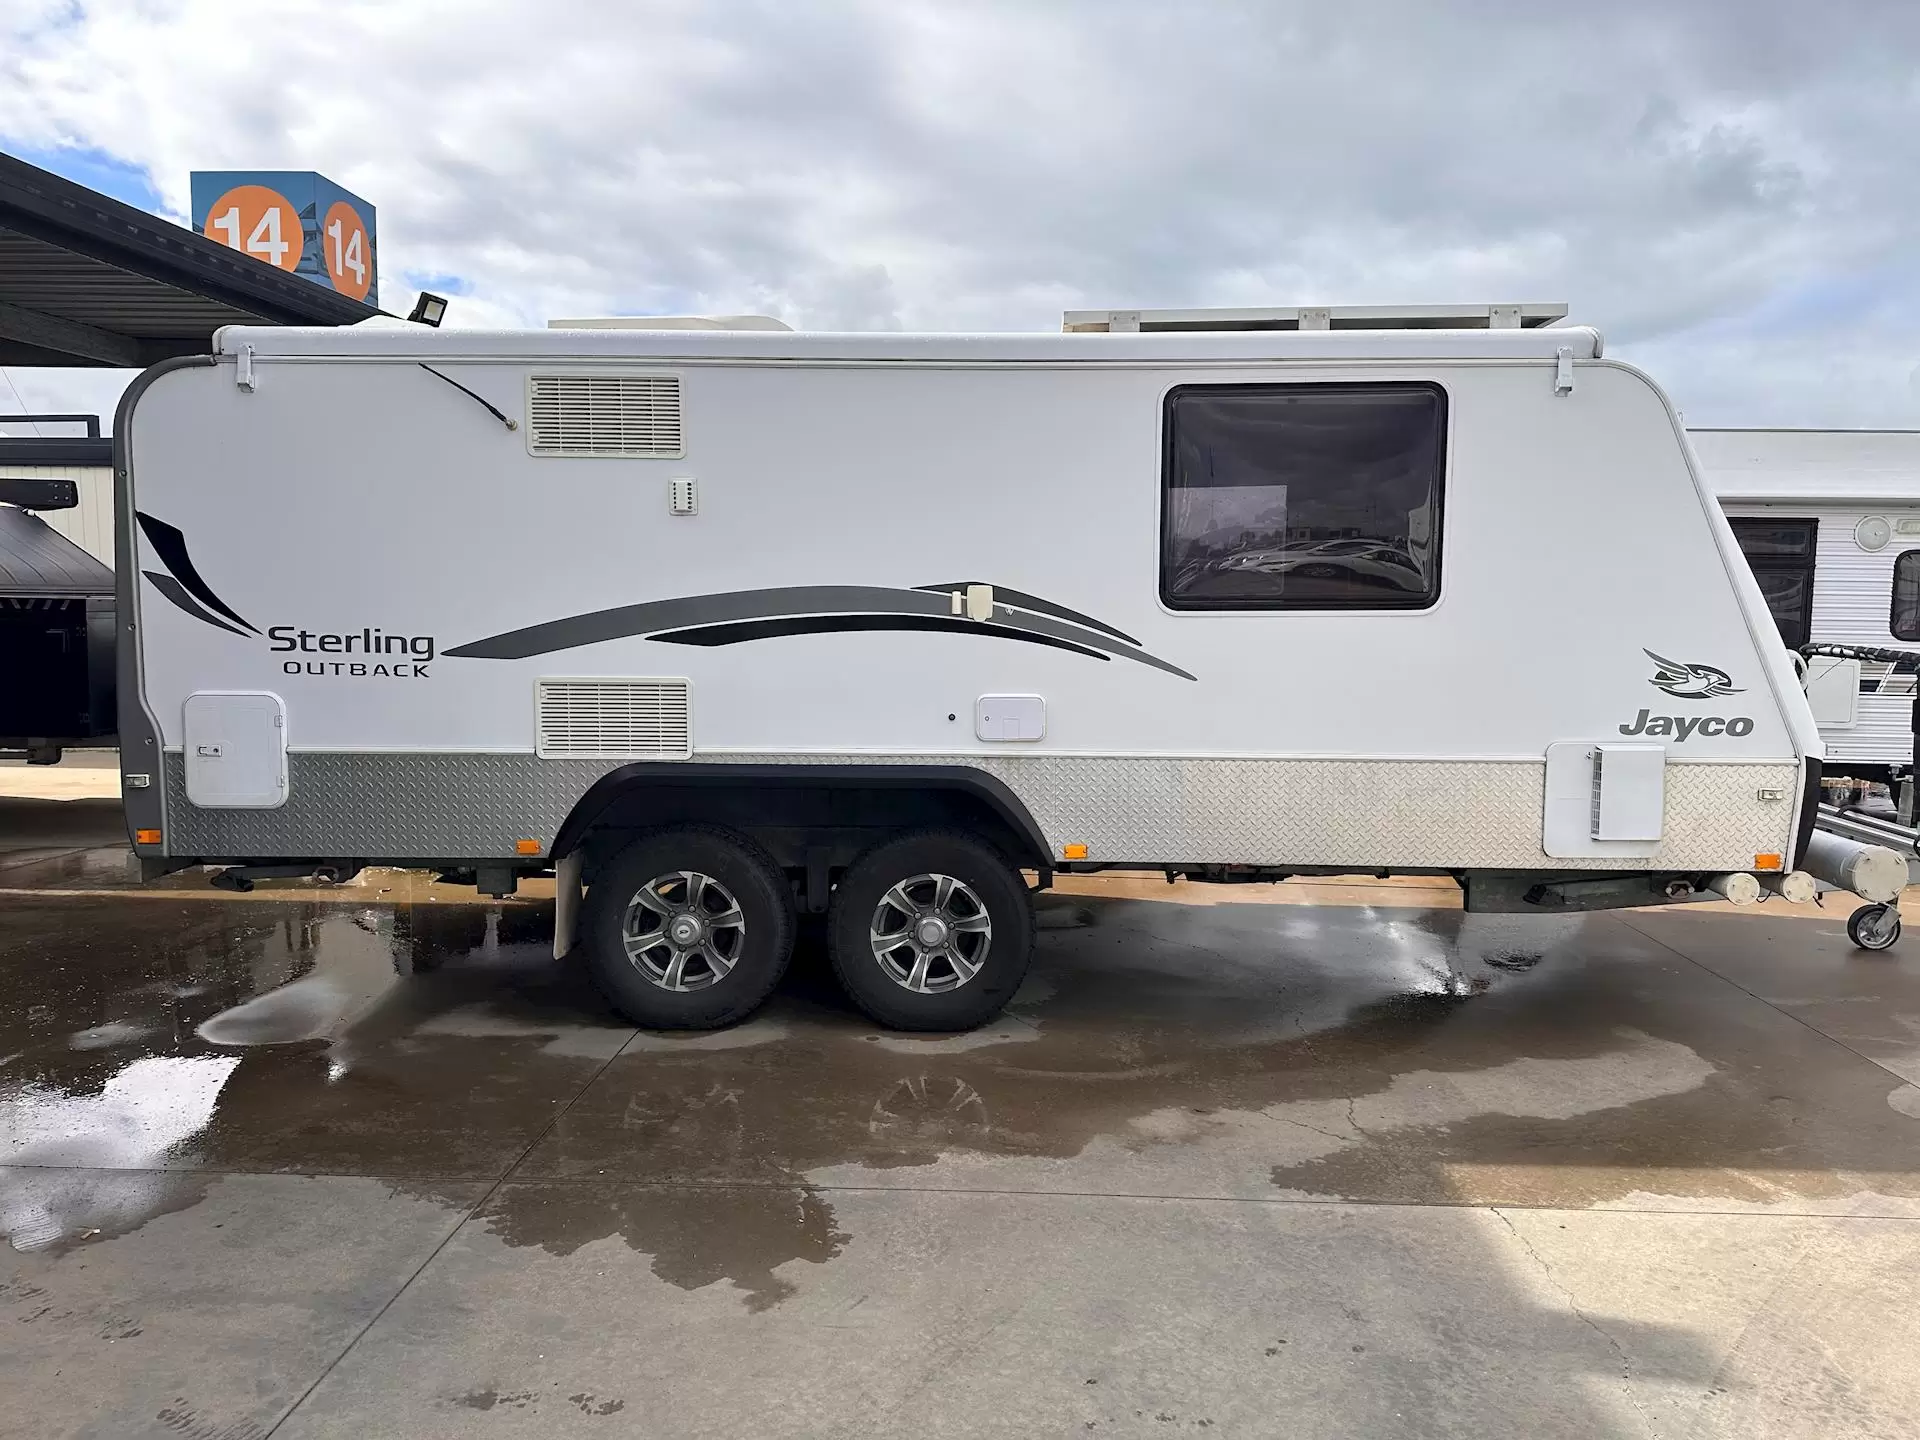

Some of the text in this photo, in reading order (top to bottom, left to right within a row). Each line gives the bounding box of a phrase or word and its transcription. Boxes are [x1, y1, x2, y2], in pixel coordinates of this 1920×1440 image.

[213, 207, 289, 264] 14
[327, 219, 366, 285] 14
[268, 626, 434, 661] Sterling
[283, 661, 430, 678] OUTBACK
[1619, 709, 1754, 743] Jayco
